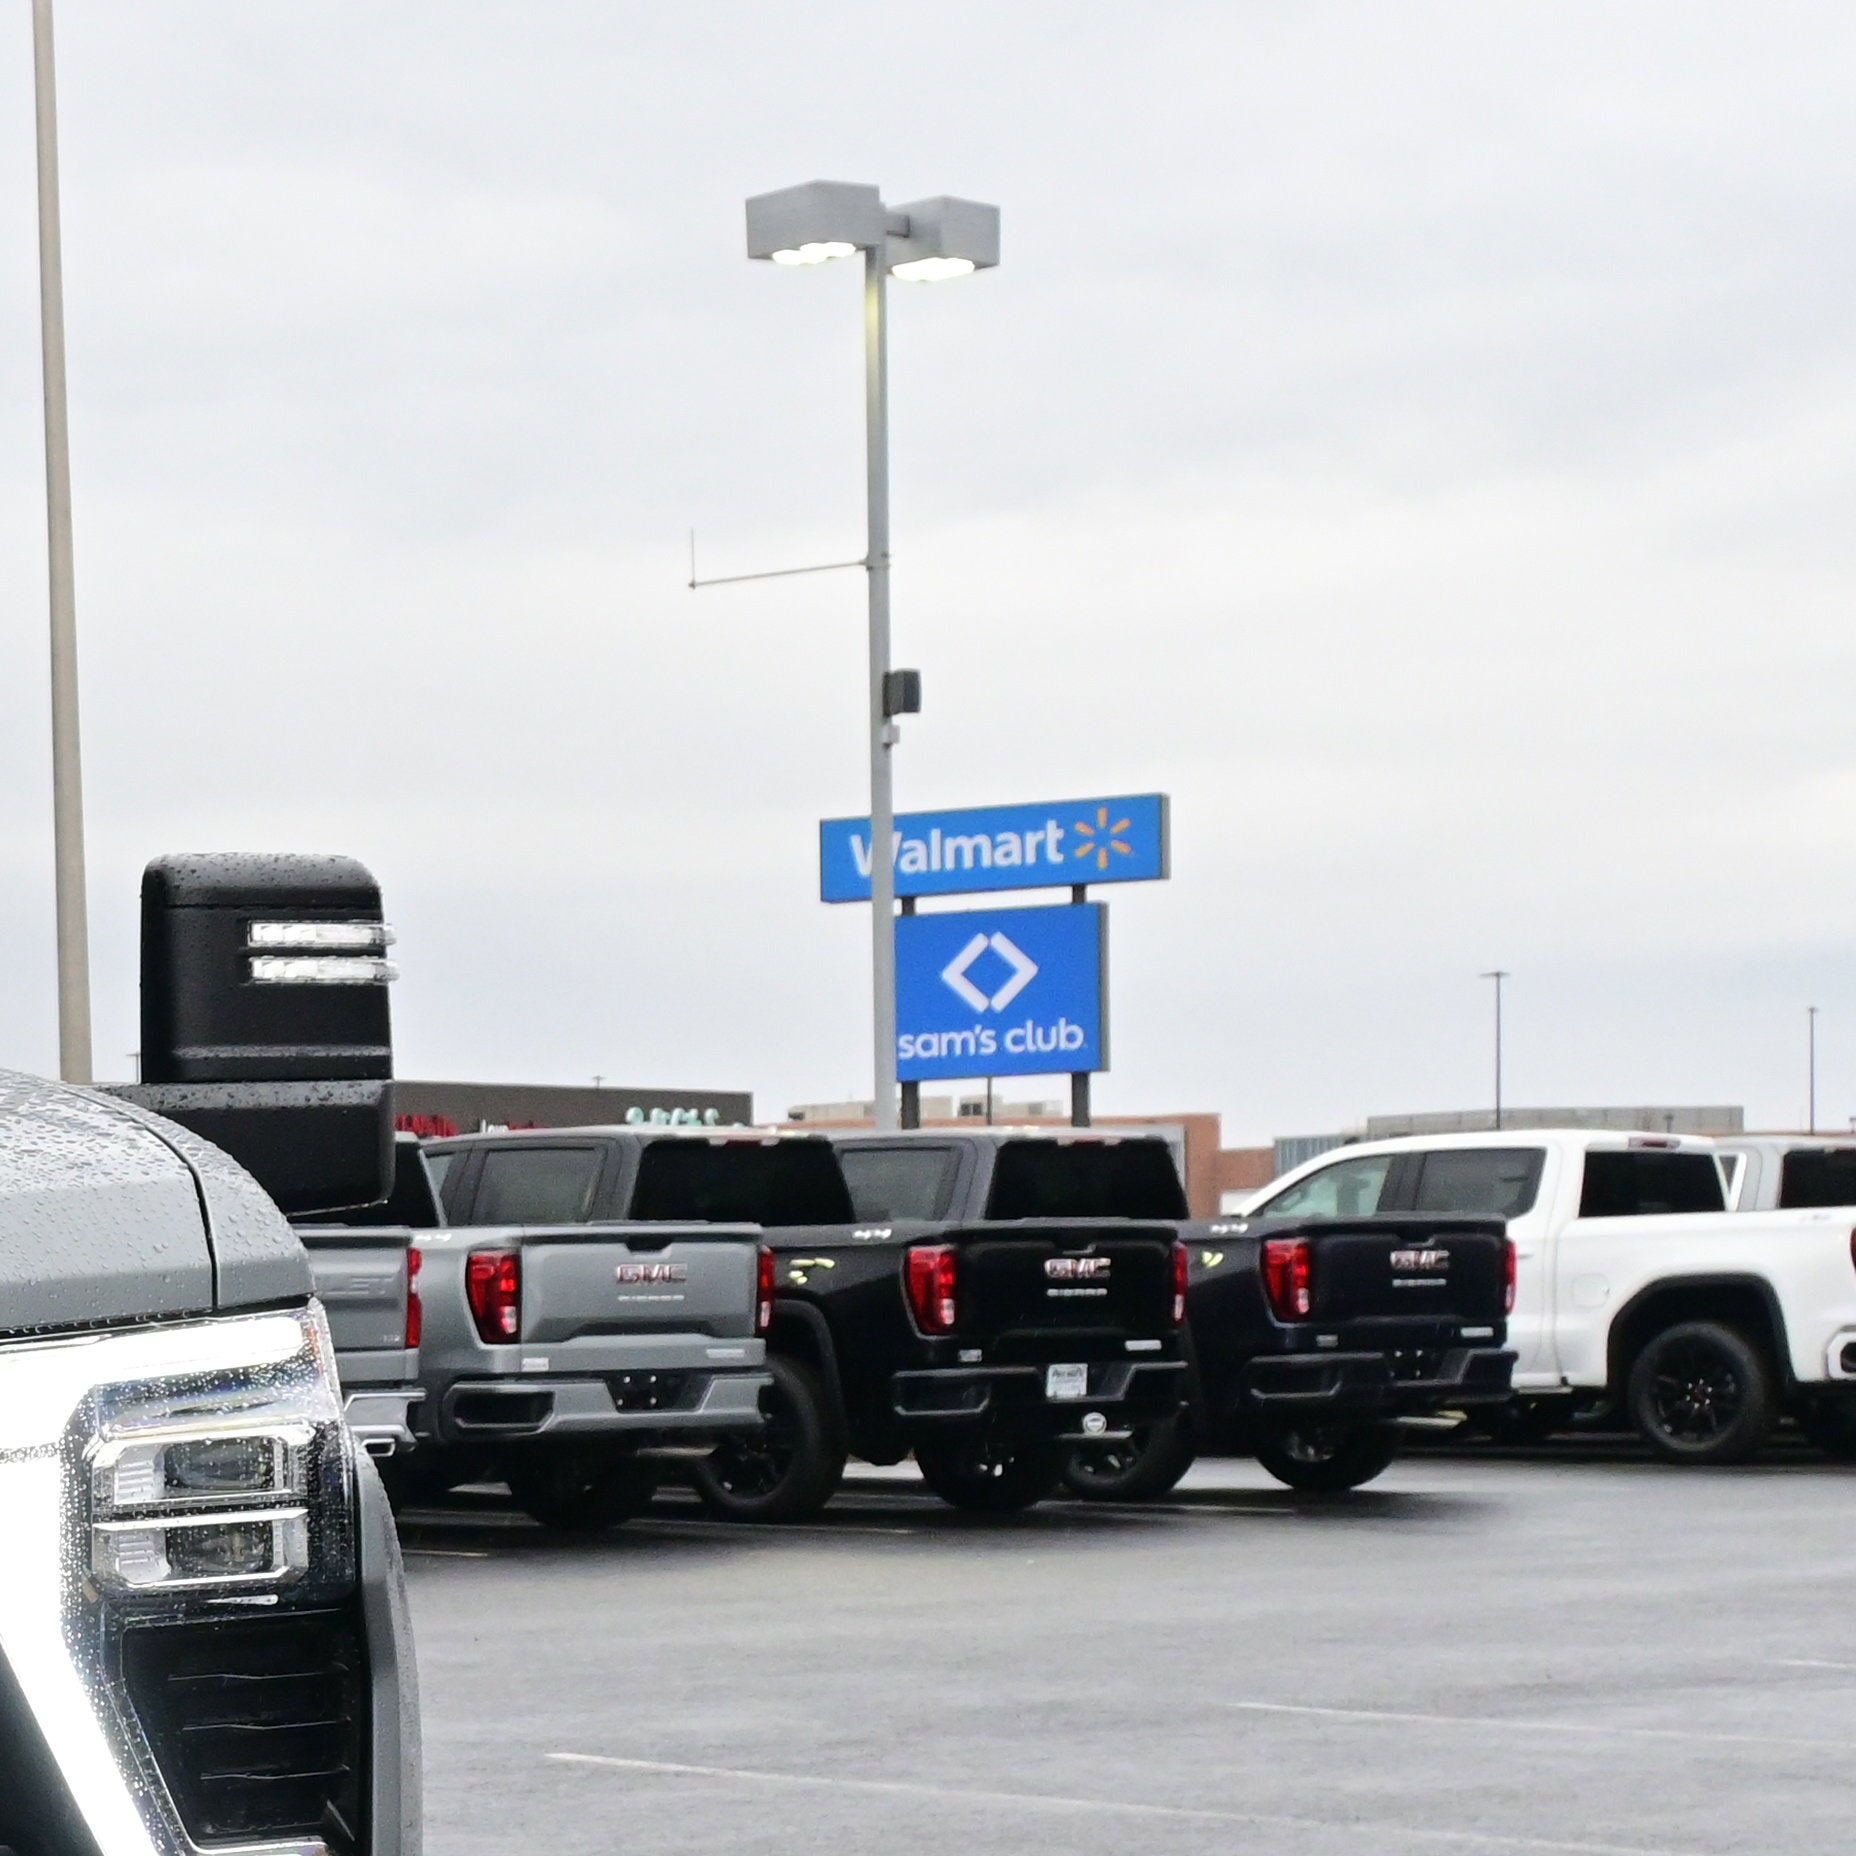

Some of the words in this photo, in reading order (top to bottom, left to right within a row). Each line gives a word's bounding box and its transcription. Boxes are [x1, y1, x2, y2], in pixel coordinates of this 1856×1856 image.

[850, 819, 1065, 878] Walmart
[898, 1023, 998, 1060] sam's
[1004, 1016, 1085, 1053] club
[1044, 1258, 1111, 1278] GMC
[1390, 1249, 1450, 1270] GMC
[617, 1263, 688, 1283] GMC
